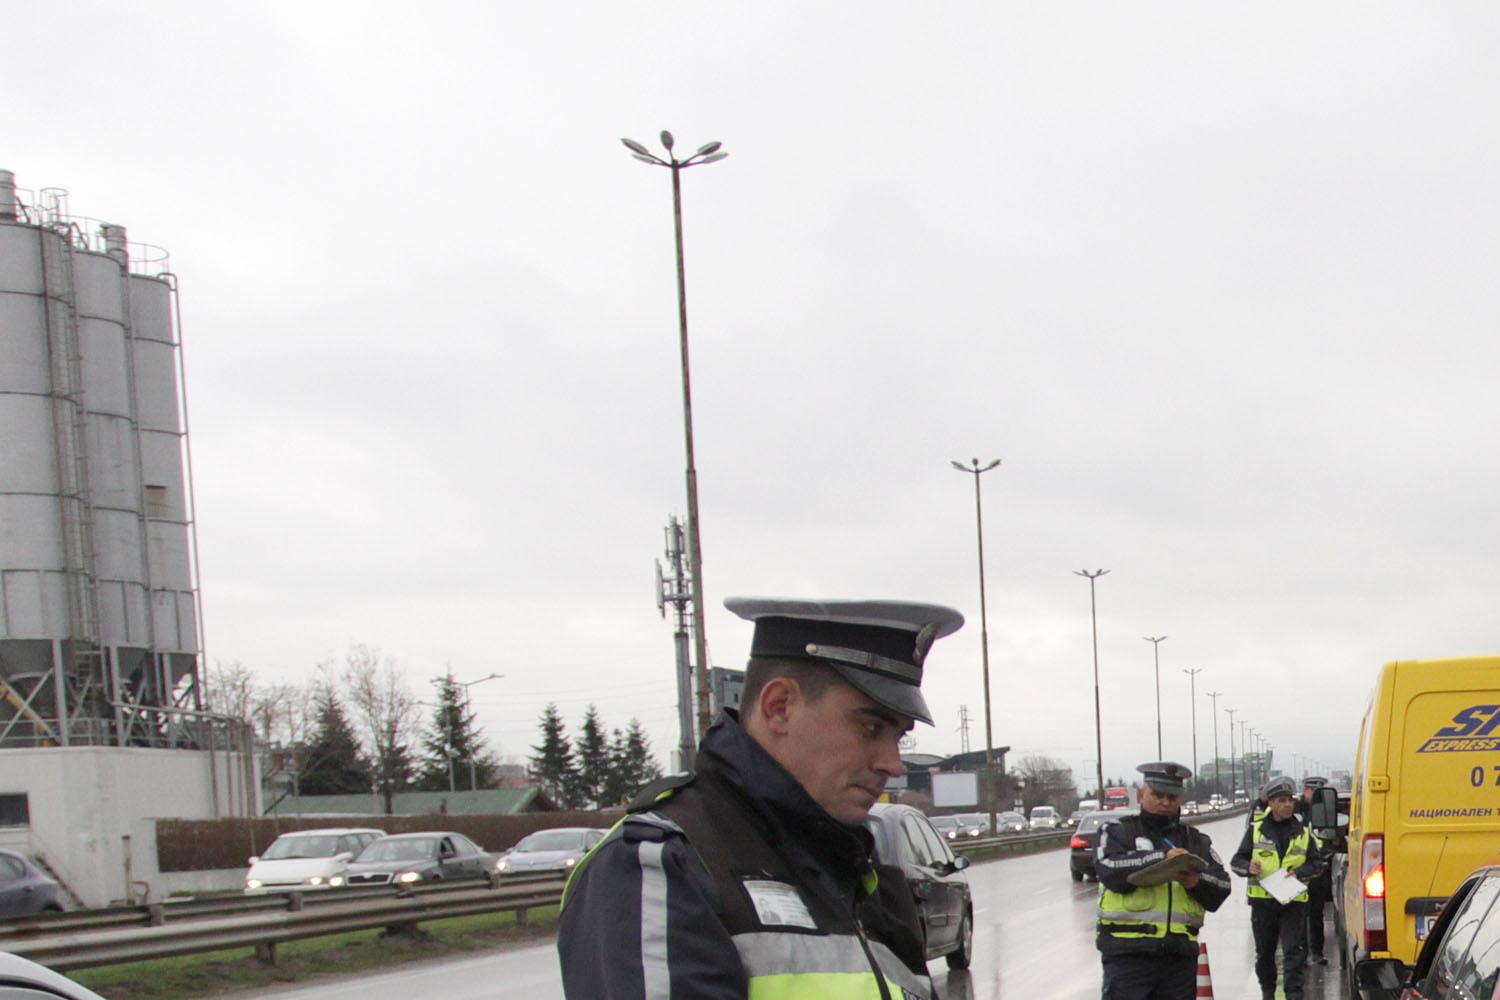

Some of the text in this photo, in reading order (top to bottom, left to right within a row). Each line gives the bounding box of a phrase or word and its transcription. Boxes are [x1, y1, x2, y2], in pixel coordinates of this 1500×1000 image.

[1422, 738, 1500, 752] EXPRESS
[1470, 766, 1485, 787] 0
[1409, 808, 1492, 819] НАЦИОНАЛЕН
